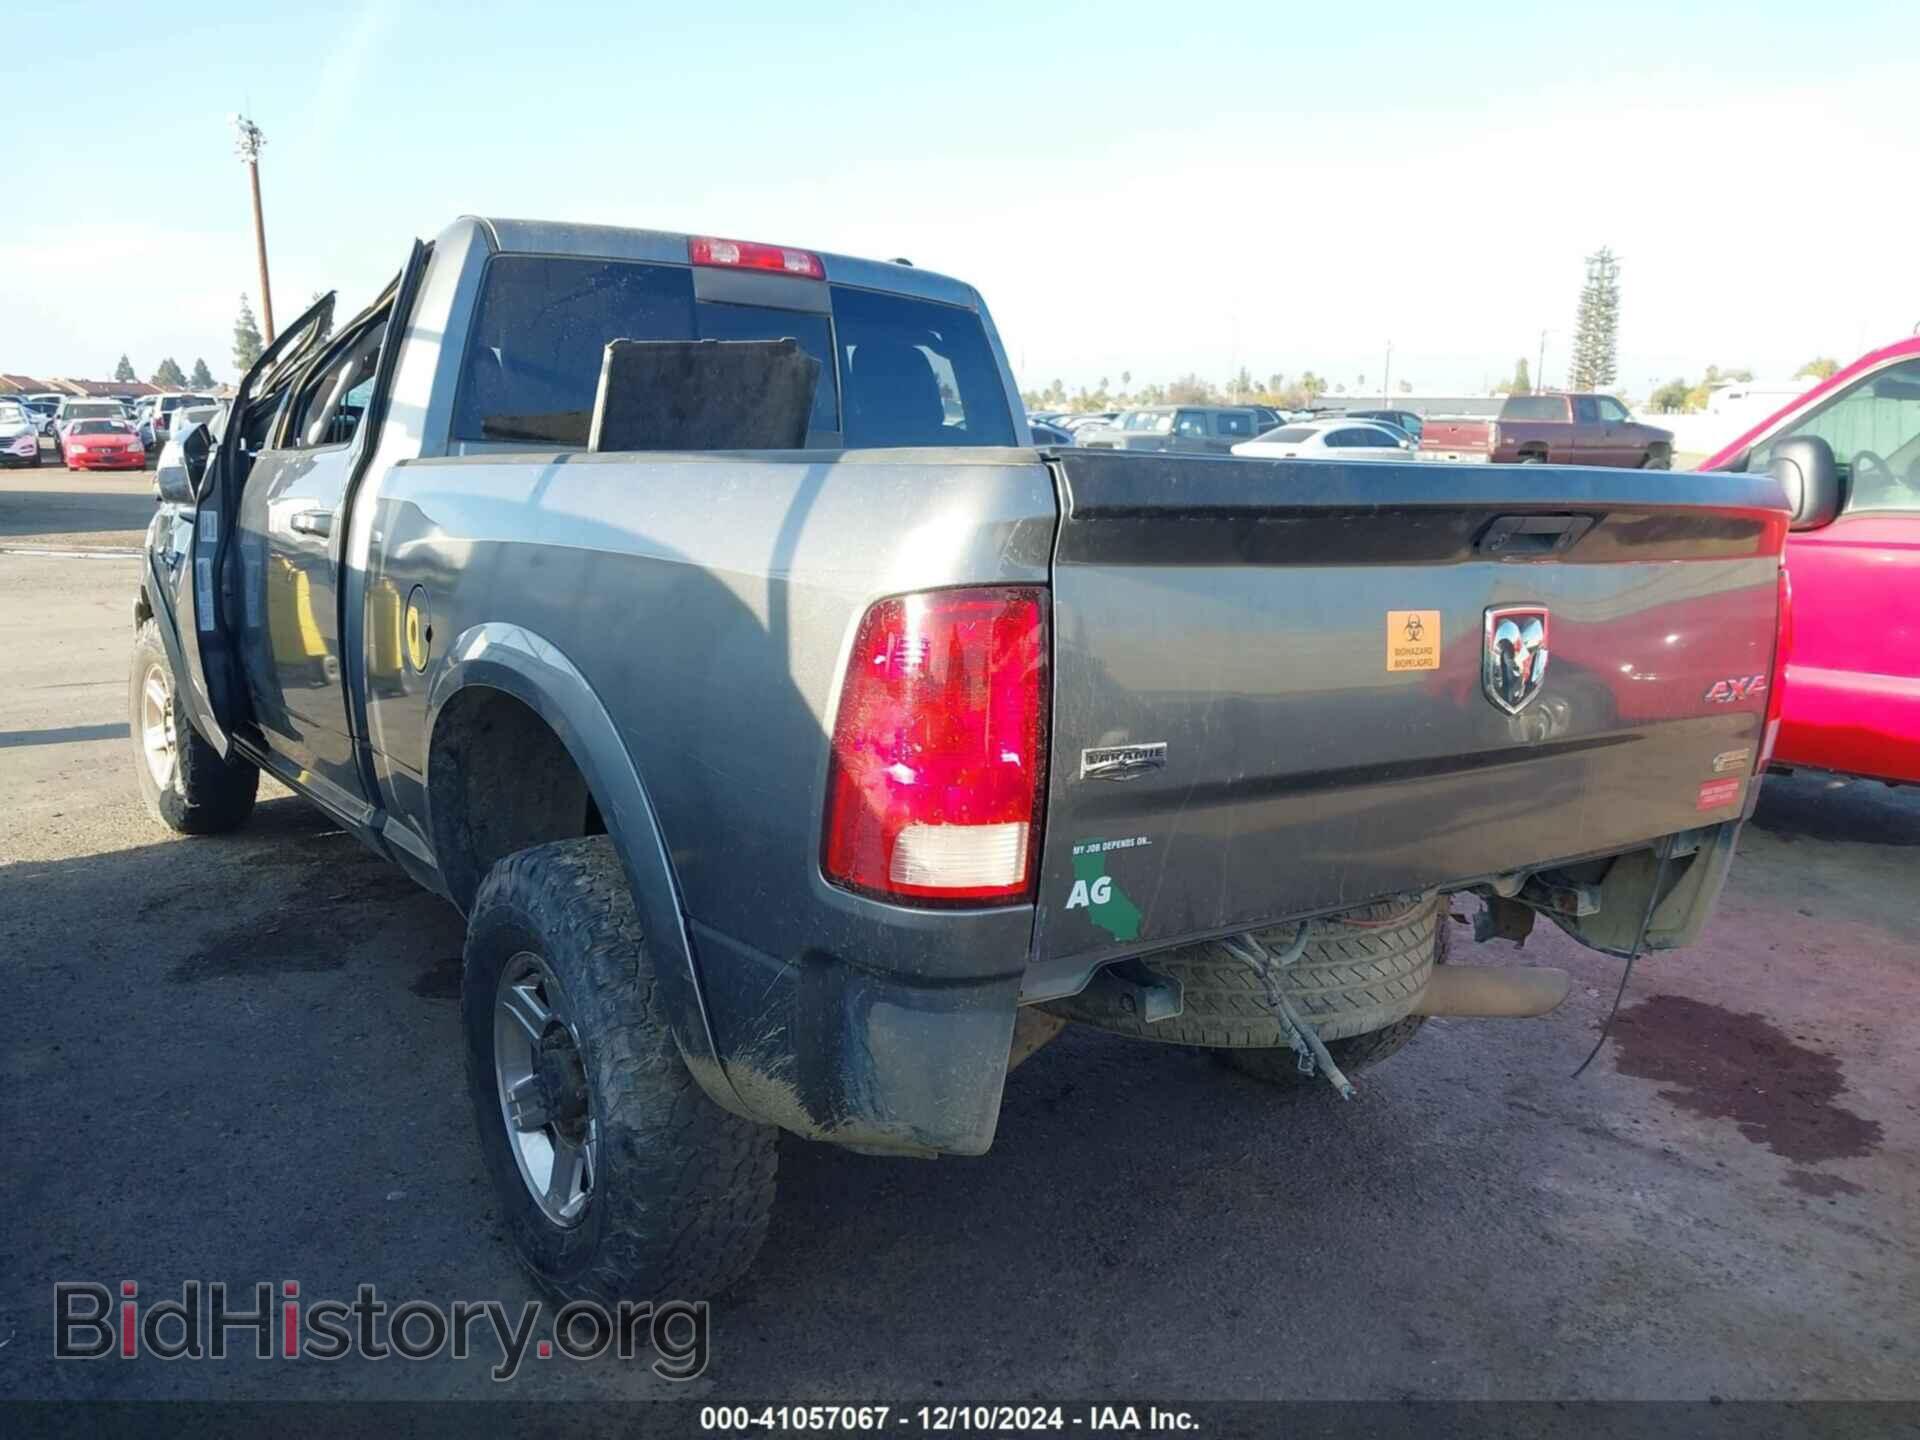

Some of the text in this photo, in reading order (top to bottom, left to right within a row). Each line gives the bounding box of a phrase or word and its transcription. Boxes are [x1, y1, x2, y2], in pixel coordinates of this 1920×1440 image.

[1073, 845, 1085, 855] MY
[1086, 843, 1101, 853] JOB
[1102, 838, 1135, 851] DEPENDS
[1065, 876, 1112, 909] AG
